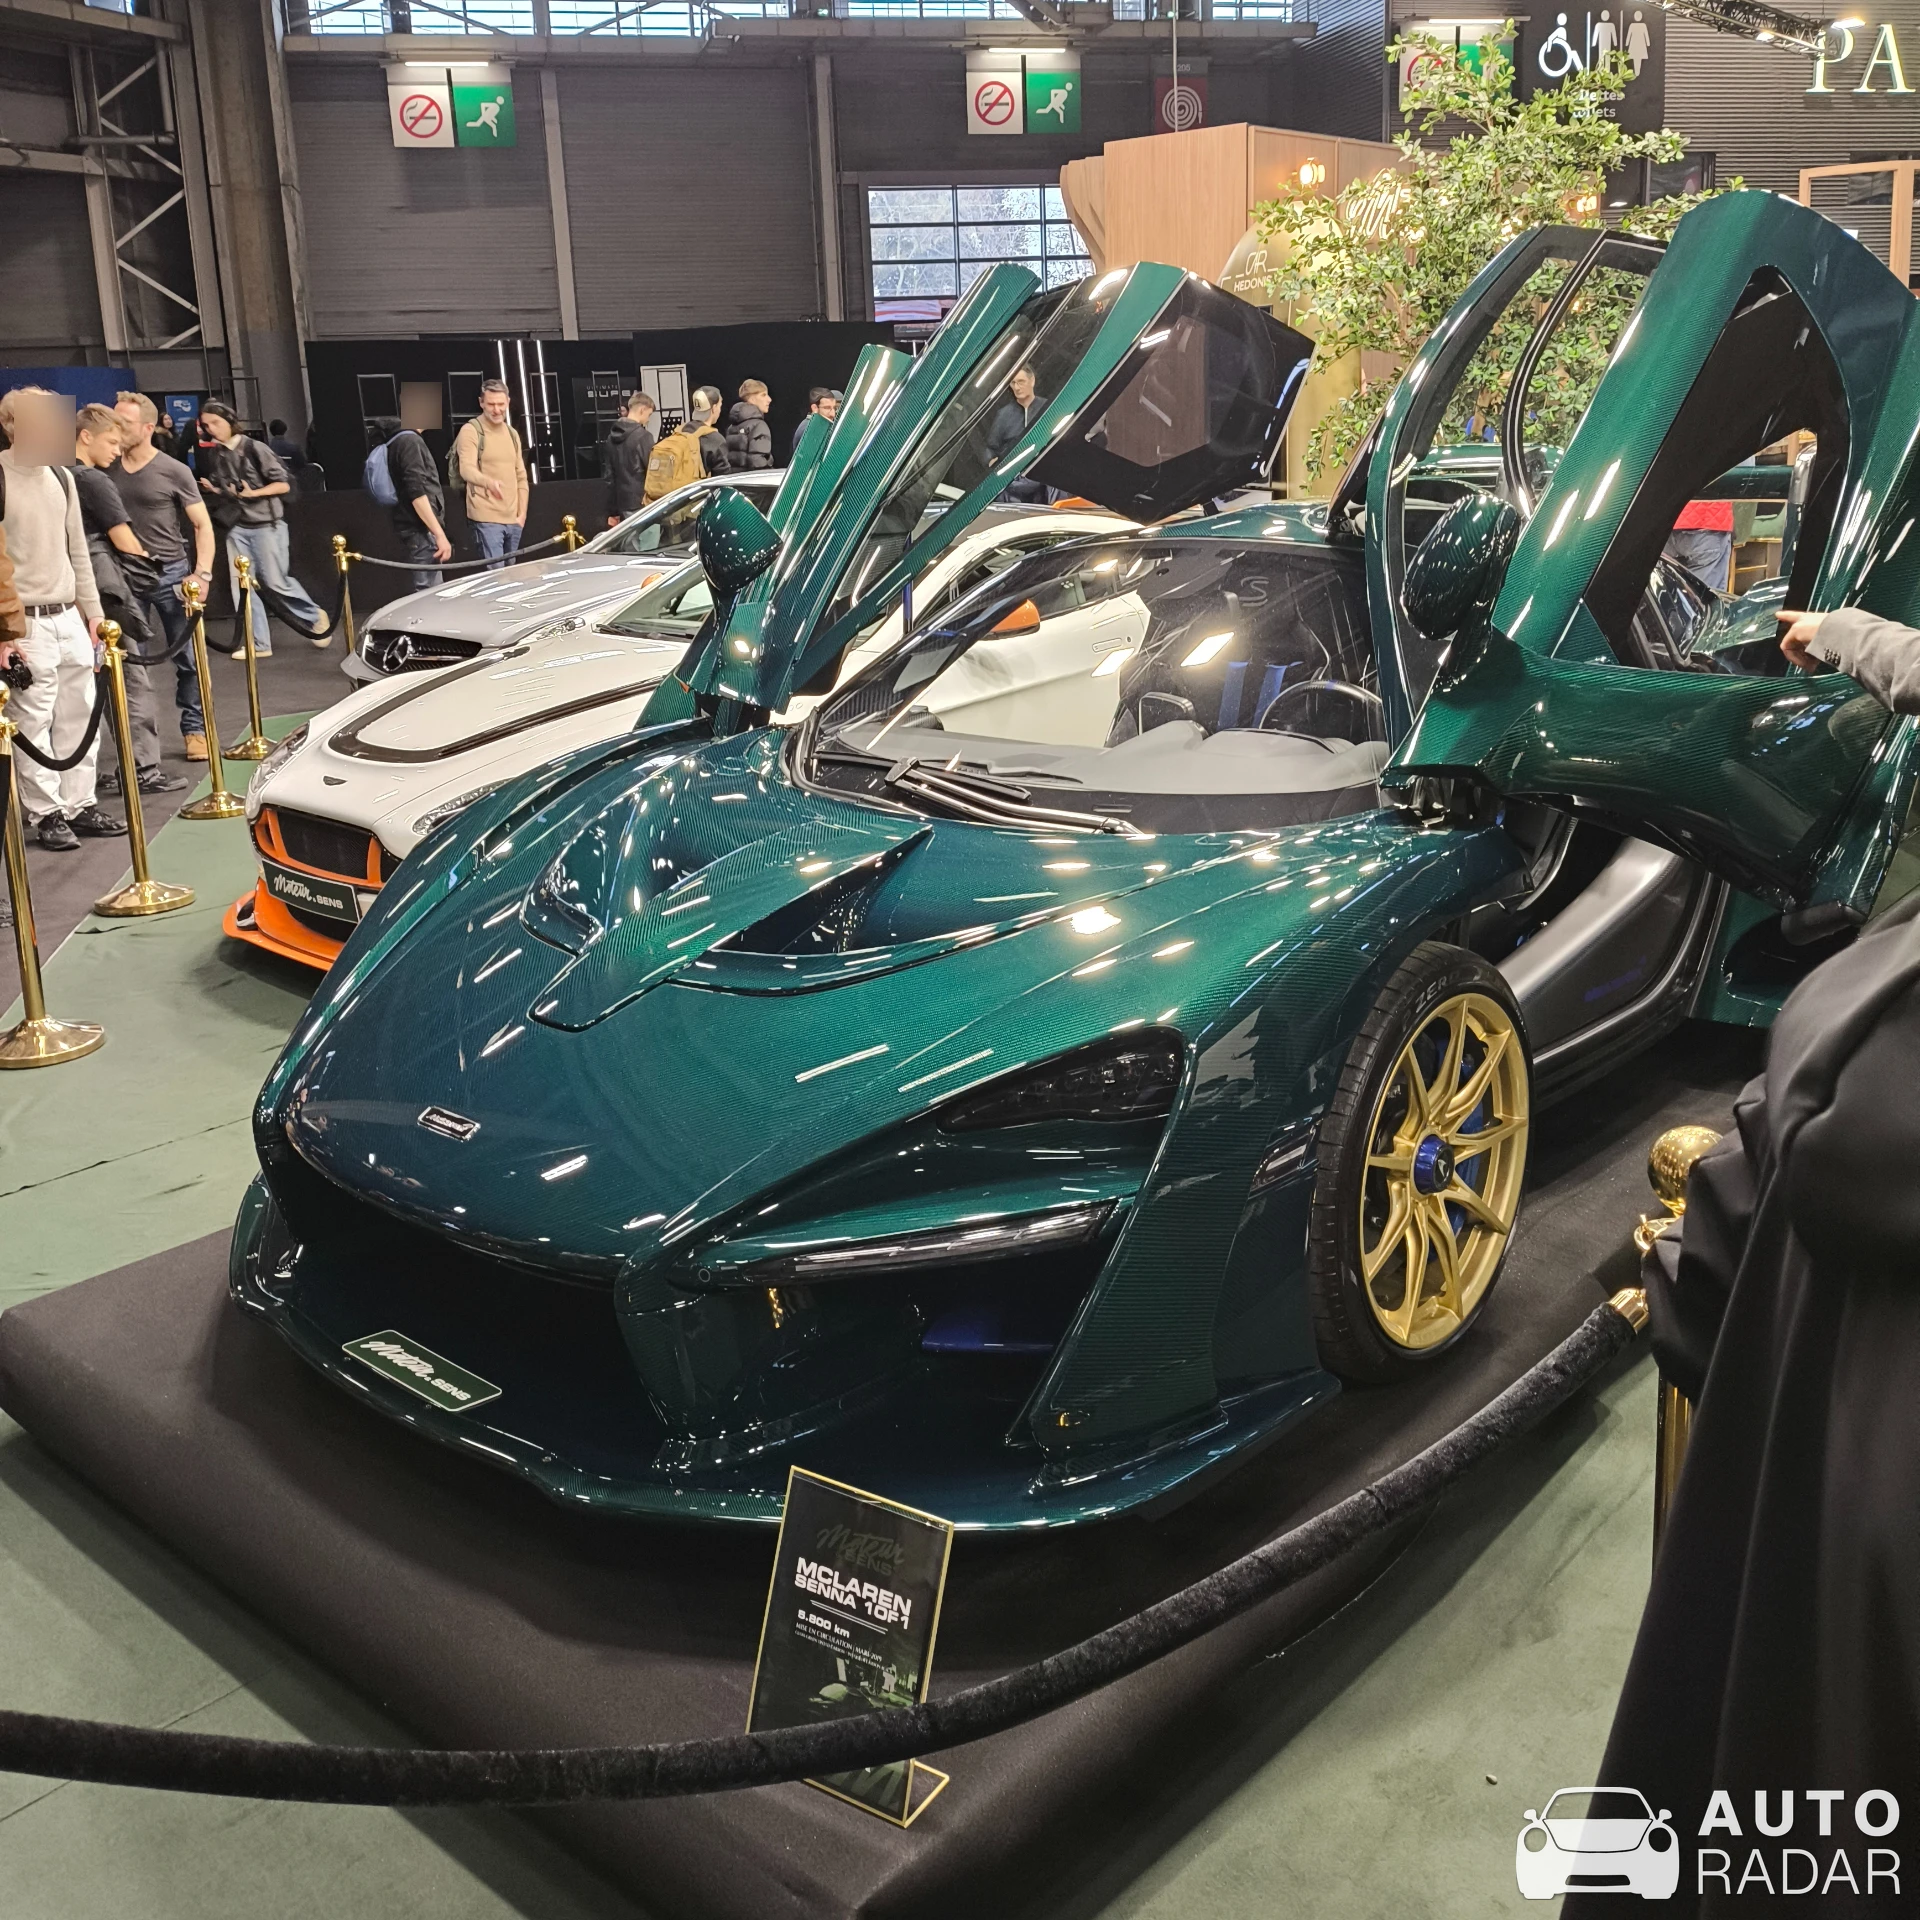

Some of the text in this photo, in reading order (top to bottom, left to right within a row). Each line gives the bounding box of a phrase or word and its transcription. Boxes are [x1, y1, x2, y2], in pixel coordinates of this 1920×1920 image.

[587, 390, 638, 398] SUPE
[794, 1573, 857, 1610] SENNA
[796, 1556, 912, 1617] MCLAREN
[834, 1623, 850, 1638] km
